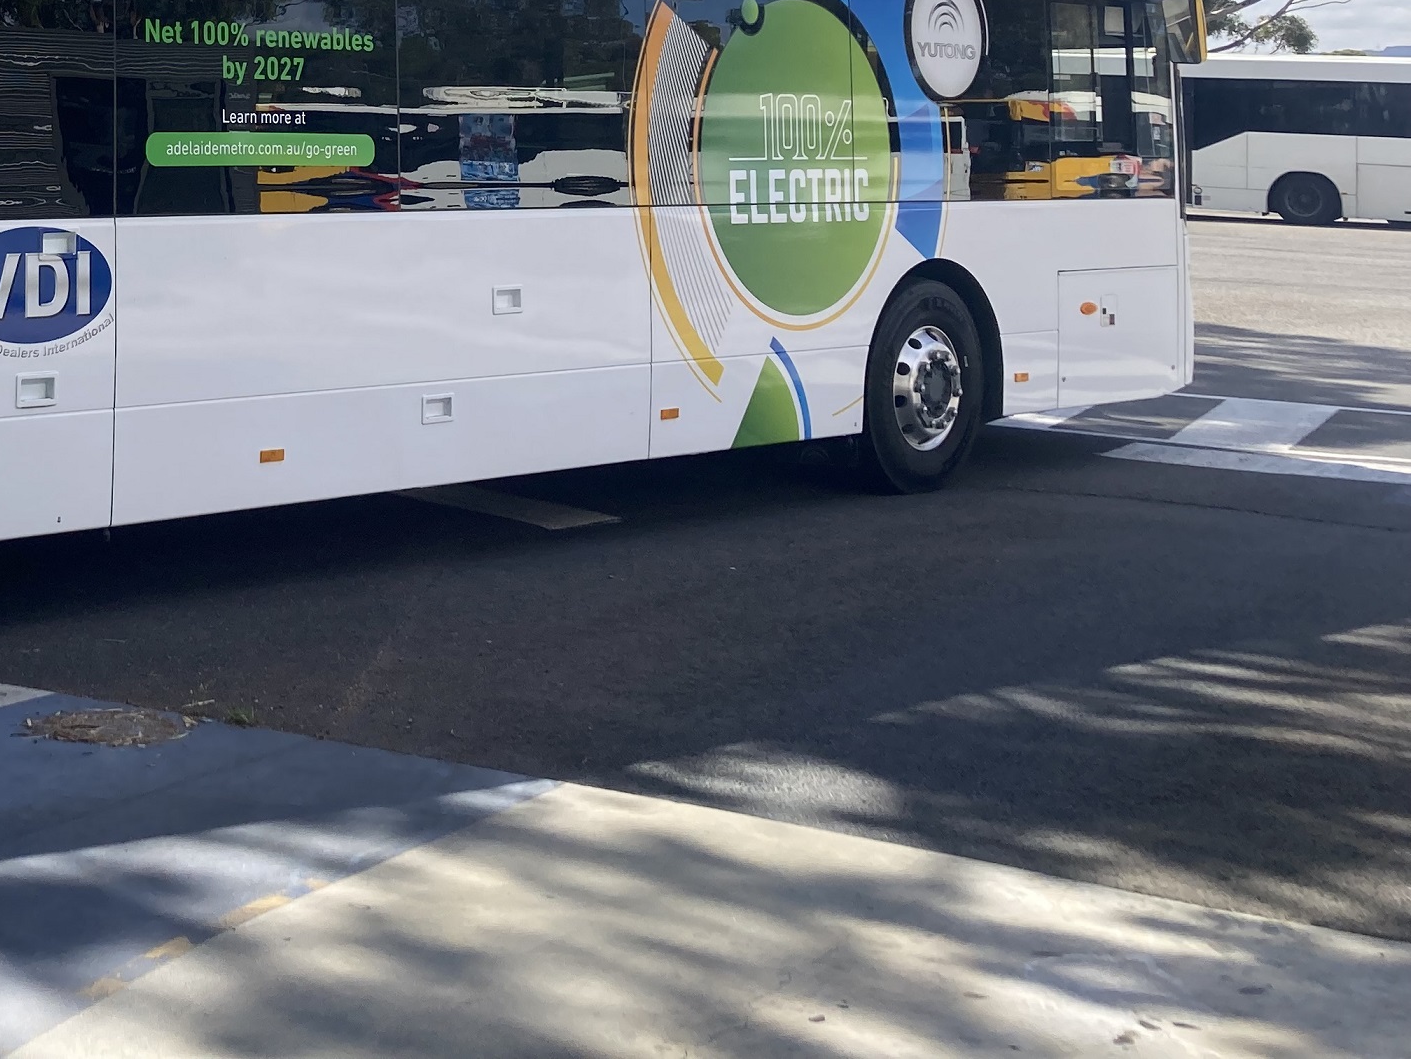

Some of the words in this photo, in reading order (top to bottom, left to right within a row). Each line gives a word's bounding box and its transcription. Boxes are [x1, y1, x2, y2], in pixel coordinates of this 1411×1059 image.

[145, 18, 183, 44] Net
[191, 20, 249, 47] 100%
[255, 27, 375, 52] renewables
[916, 41, 977, 61] YUTONG
[222, 54, 247, 85] by
[253, 56, 305, 81] 2027
[222, 108, 257, 124] Learn
[261, 113, 292, 125] more
[294, 111, 306, 125] at
[759, 92, 853, 161] 100%
[166, 141, 357, 159] adelaidemetro.com.au/go-green
[729, 168, 870, 225] ELECTRIC
[43, 313, 115, 357] International
